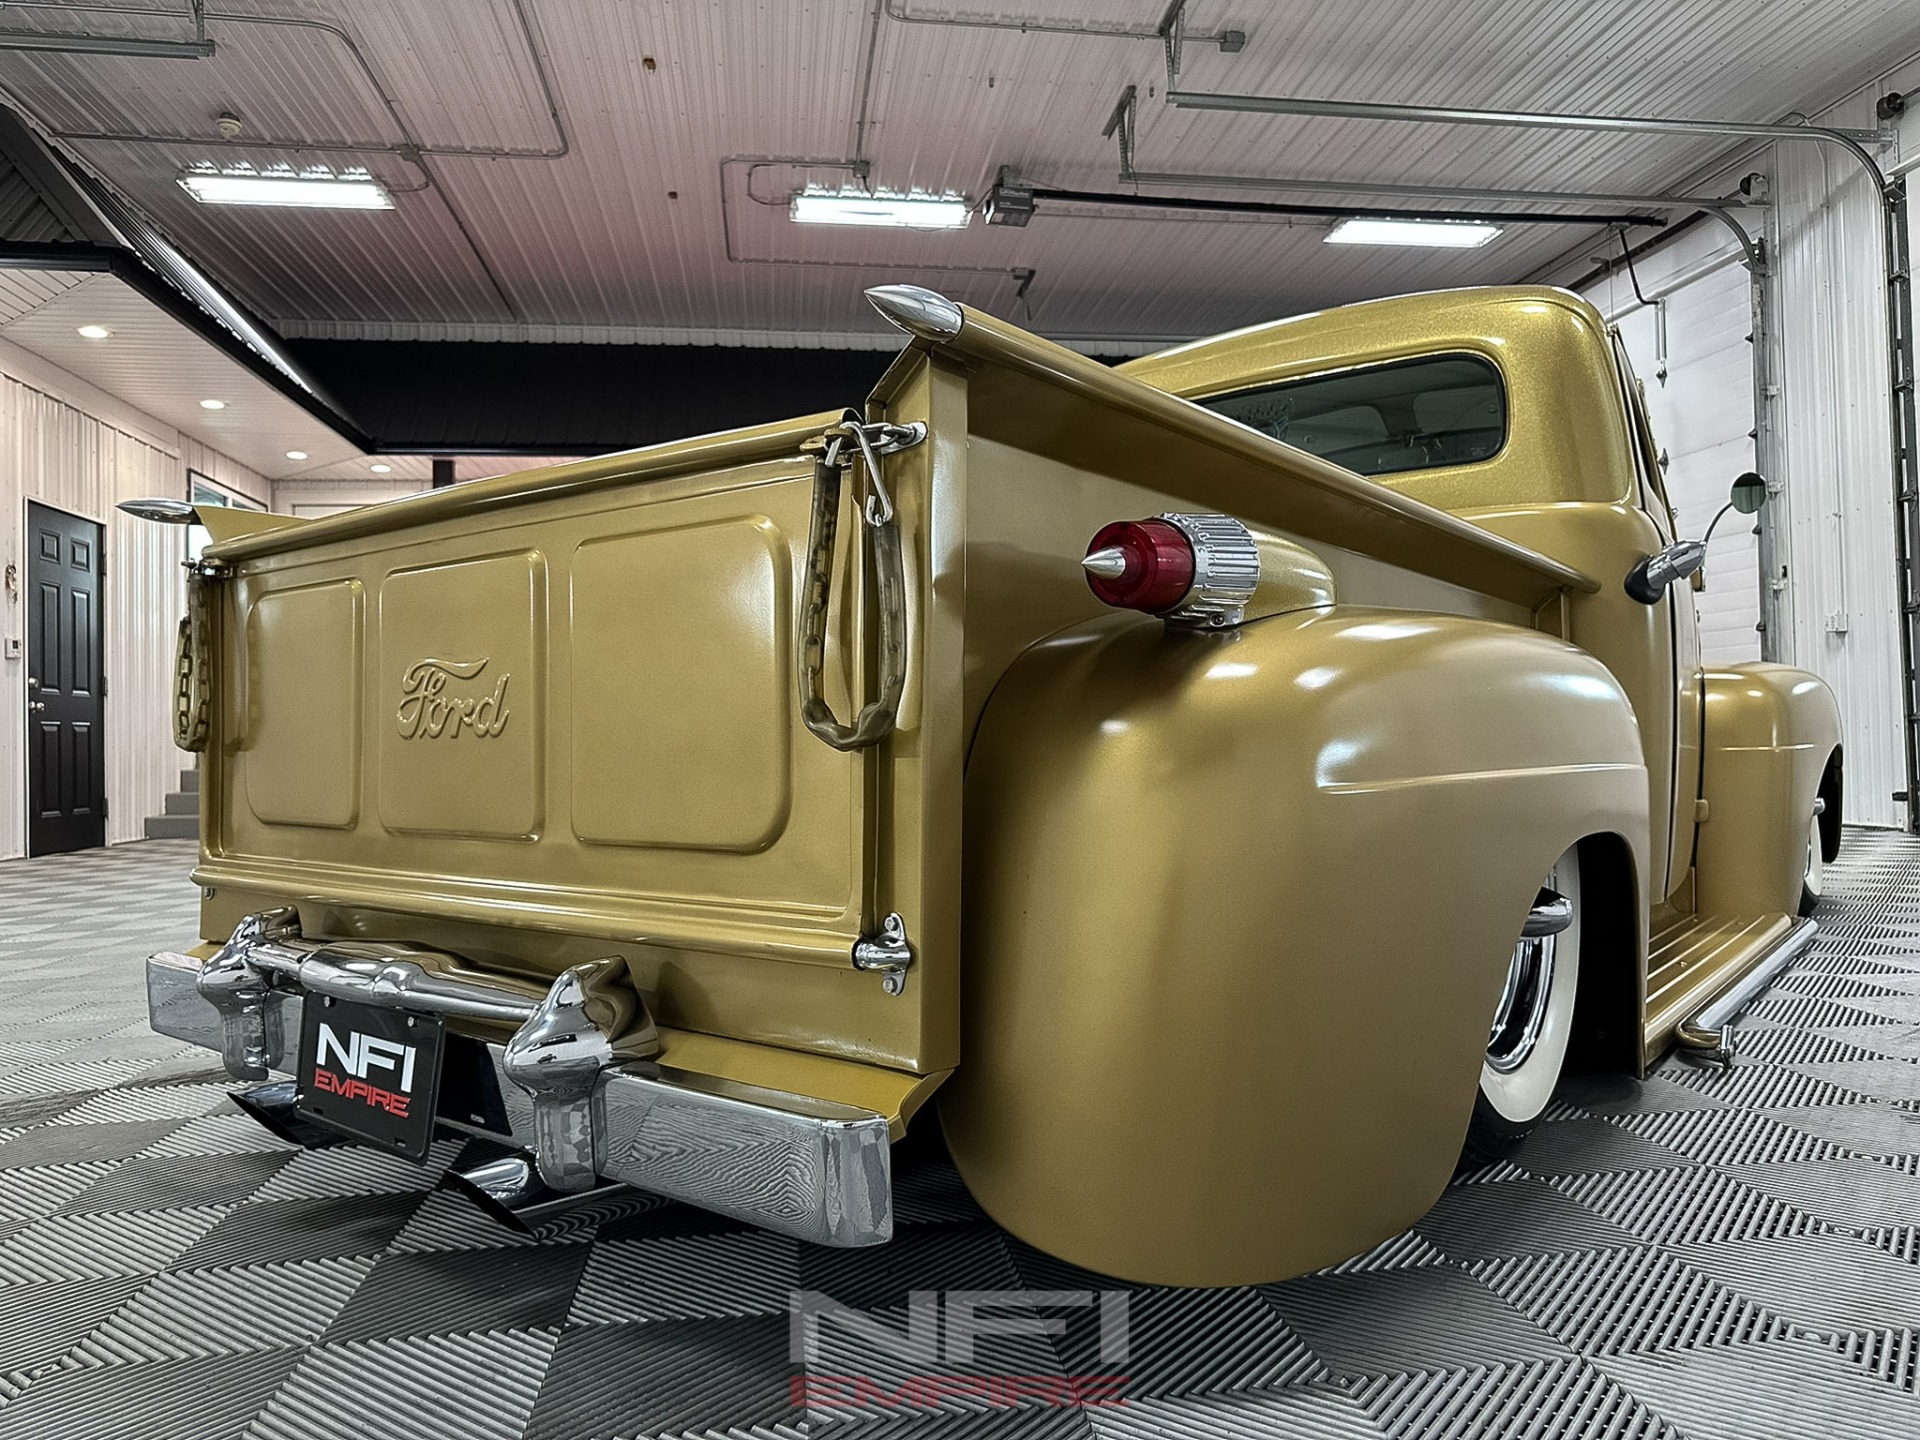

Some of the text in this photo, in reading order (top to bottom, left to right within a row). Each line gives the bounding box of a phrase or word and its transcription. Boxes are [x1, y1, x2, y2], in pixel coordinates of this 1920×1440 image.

[397, 657, 510, 740] Ford
[314, 1067, 411, 1118] EMPIRE
[316, 1022, 416, 1093] NFI
